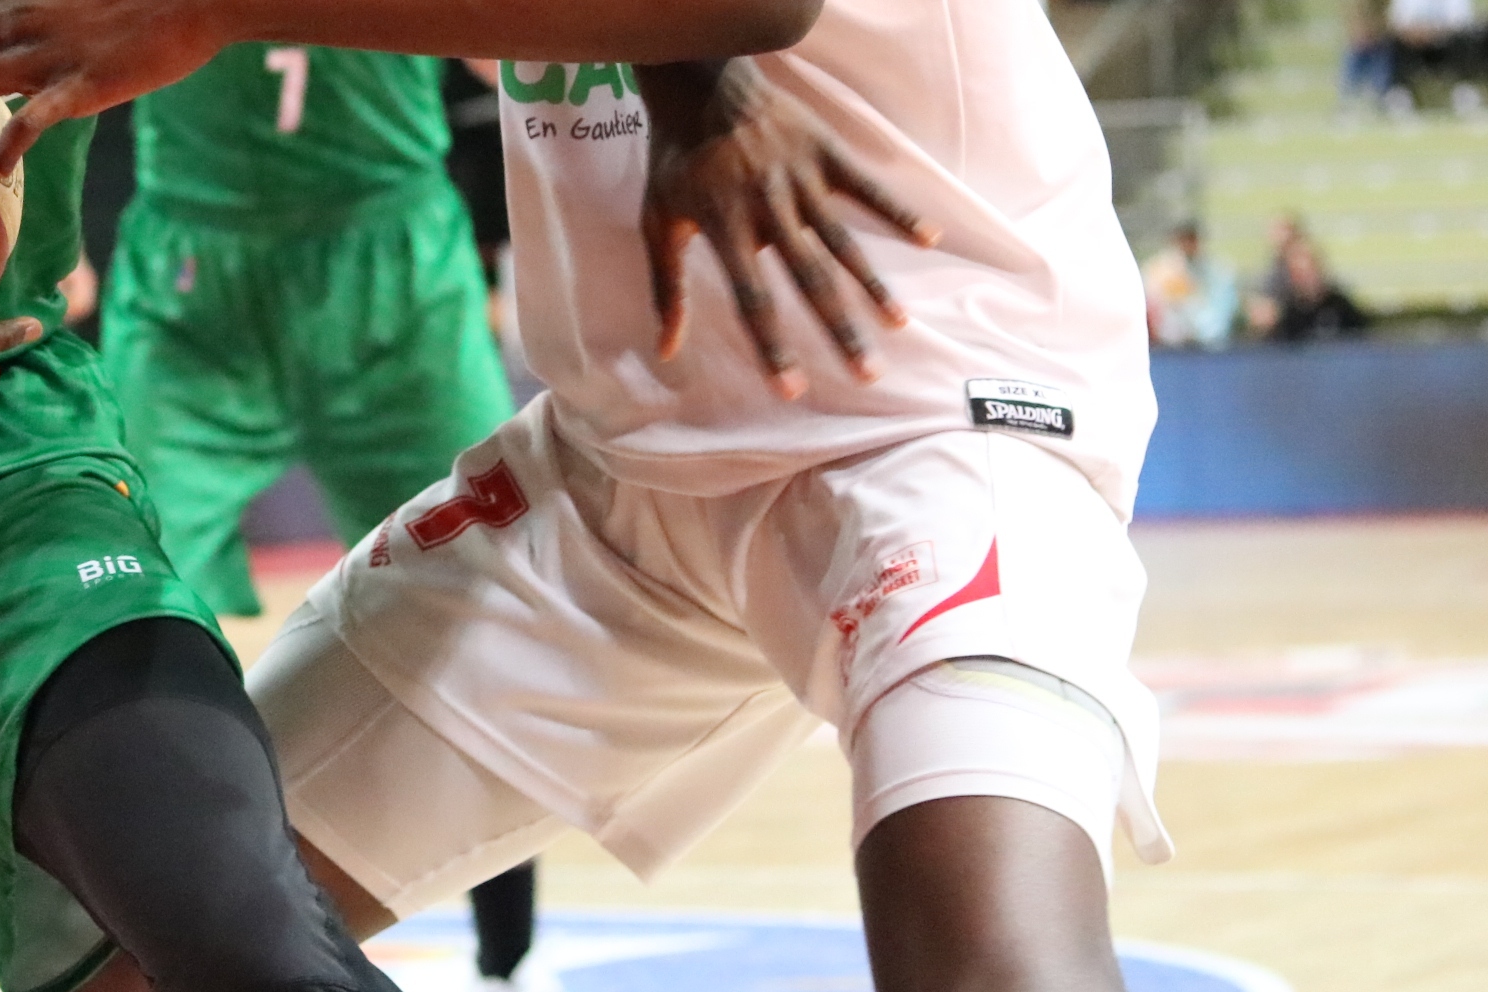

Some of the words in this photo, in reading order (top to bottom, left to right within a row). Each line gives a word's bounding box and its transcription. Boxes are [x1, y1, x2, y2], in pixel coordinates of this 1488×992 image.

[264, 46, 310, 135] 7
[525, 117, 557, 140] En
[998, 386, 1028, 396] SIZE
[985, 401, 1063, 429] SPALDING
[404, 457, 530, 552] 7
